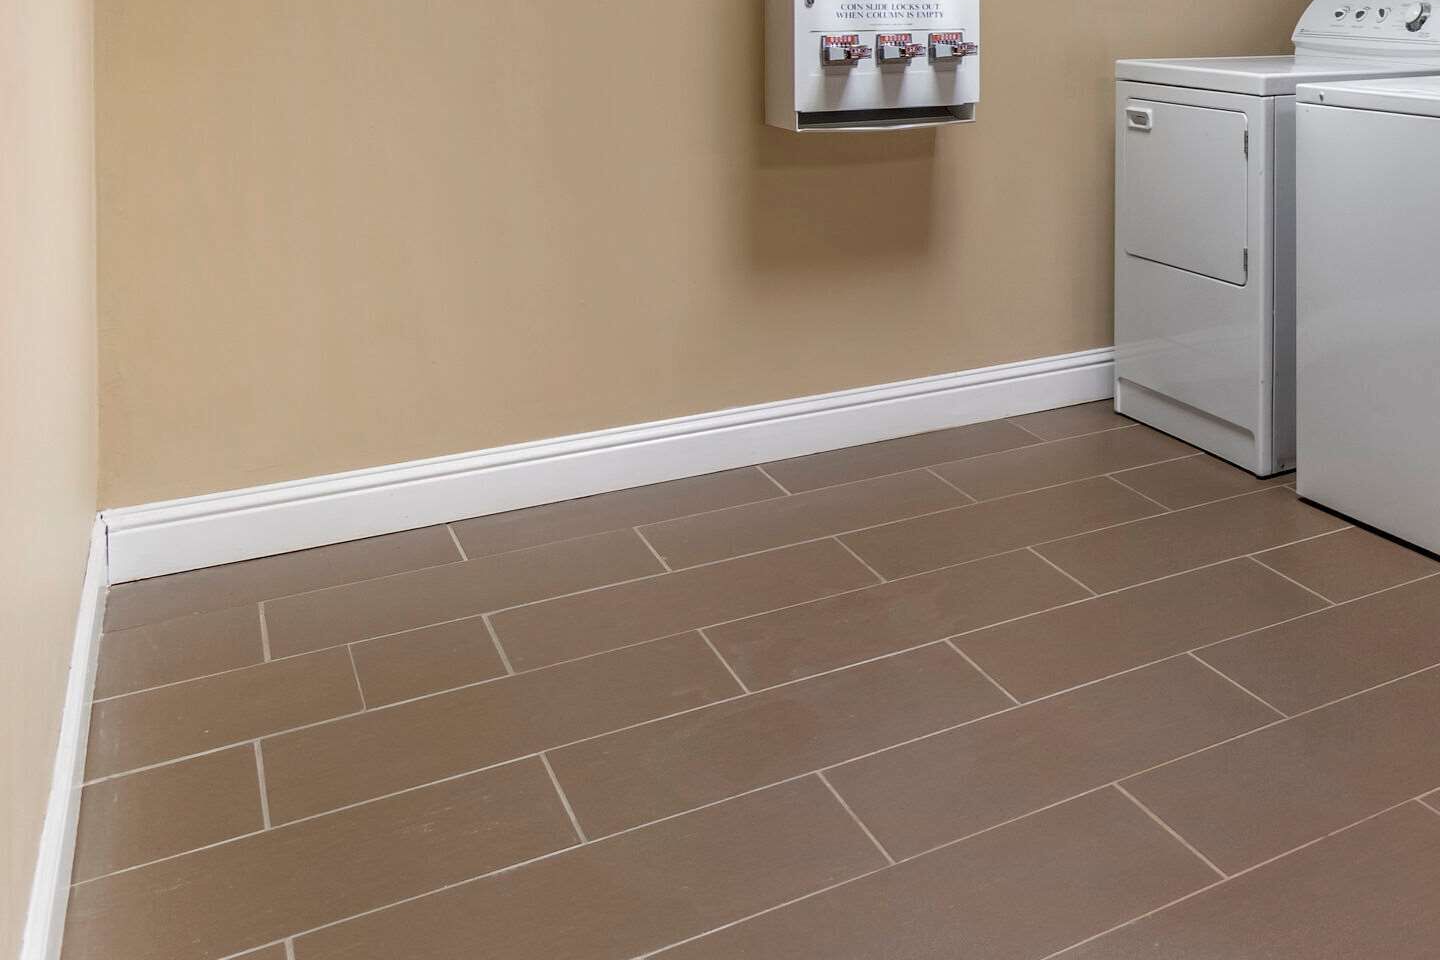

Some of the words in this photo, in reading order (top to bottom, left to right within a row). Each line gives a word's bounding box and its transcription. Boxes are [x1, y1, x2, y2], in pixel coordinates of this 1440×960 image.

[841, 3, 864, 11] COIN
[866, 3, 888, 11] SLIDE
[891, 3, 920, 11] LOCKS
[921, 3, 940, 11] OUT
[836, 11, 864, 19] WHEN
[906, 11, 915, 19] IS
[916, 11, 944, 19] EMPTY
